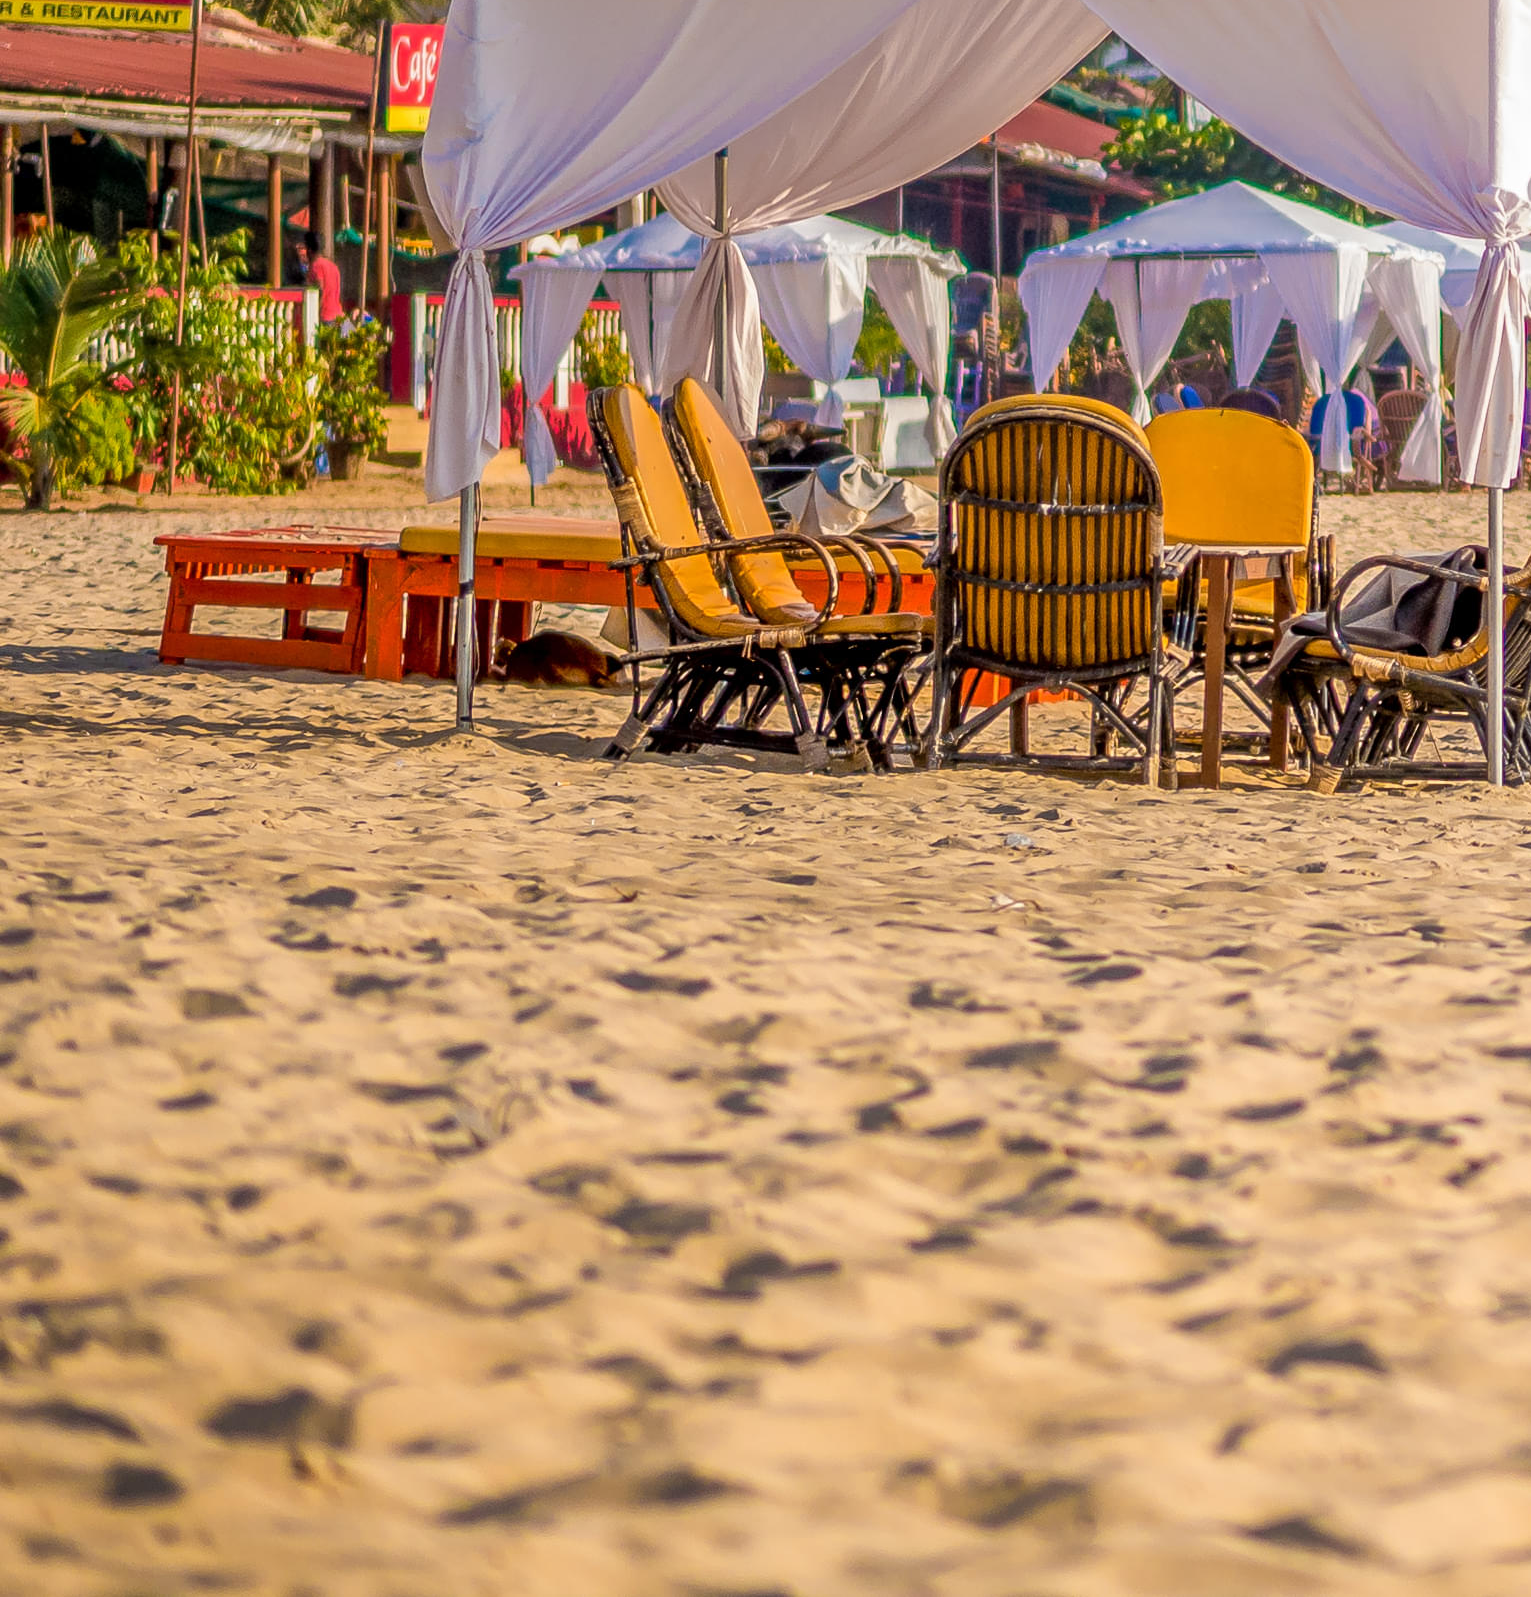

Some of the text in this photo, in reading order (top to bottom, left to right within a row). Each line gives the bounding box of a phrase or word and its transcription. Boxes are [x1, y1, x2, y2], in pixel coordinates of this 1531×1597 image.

[20, 3, 34, 17] &
[42, 4, 182, 24] RESTAURANT
[393, 36, 438, 102] Café
